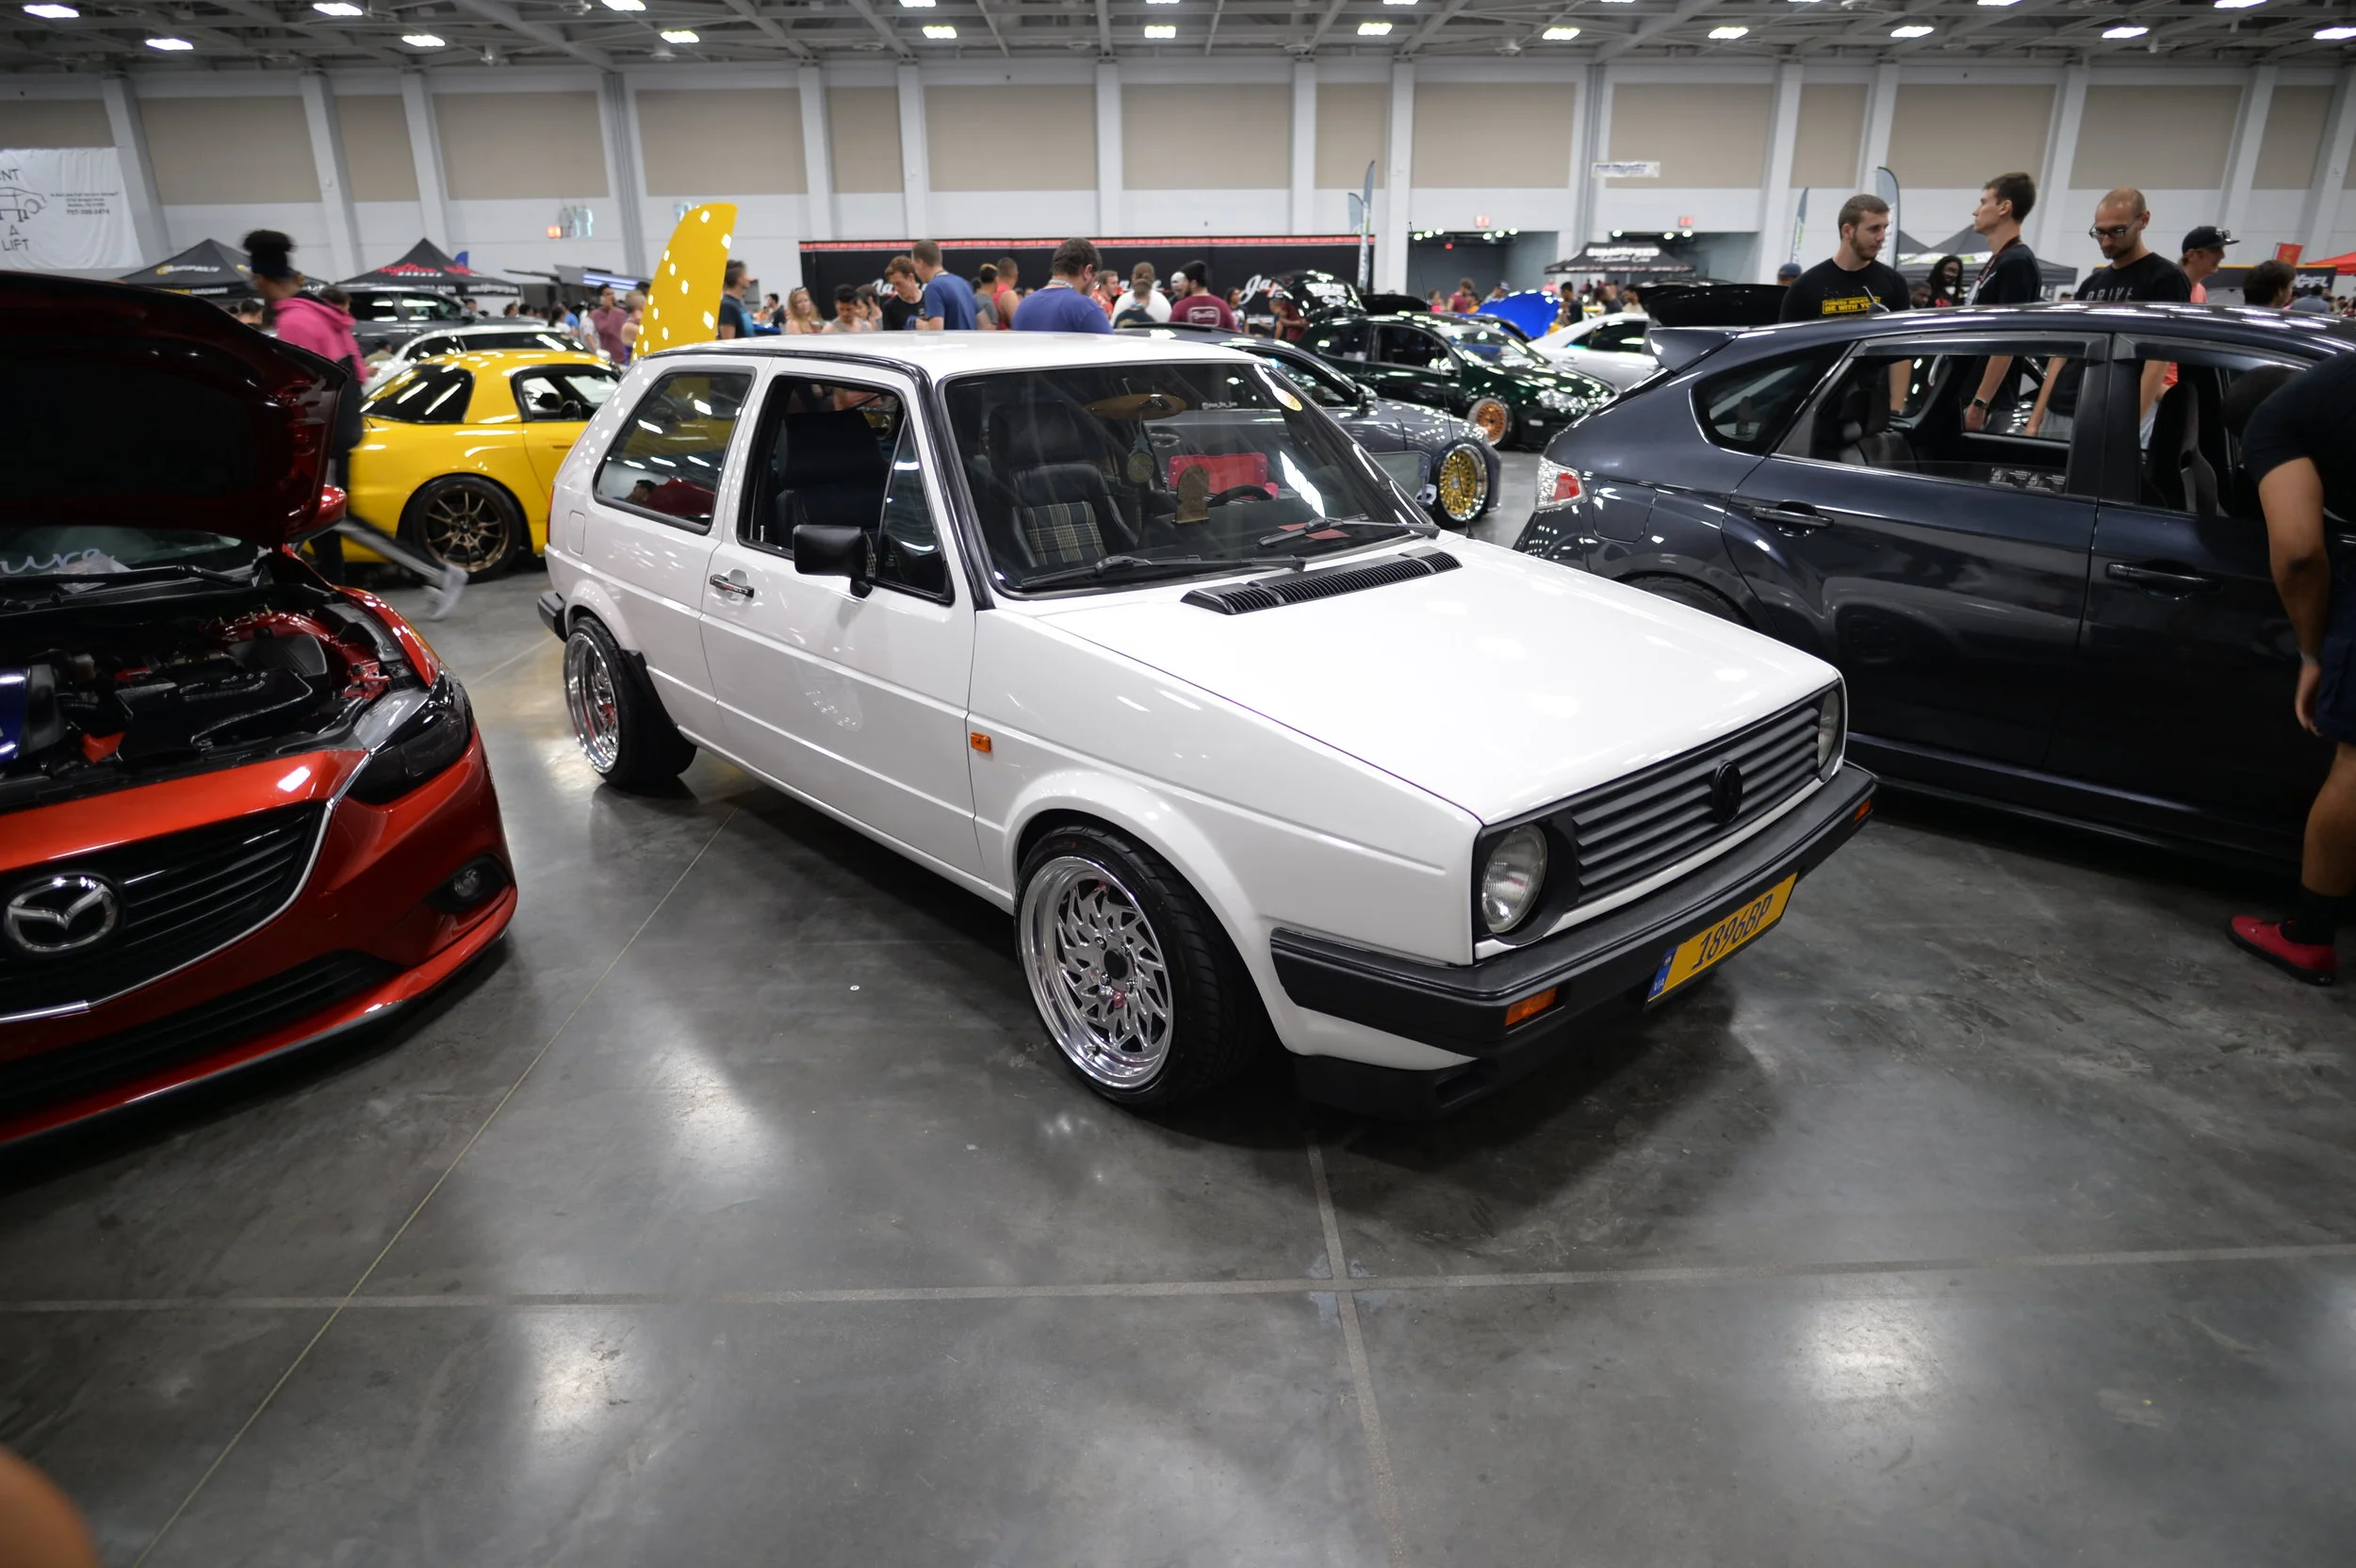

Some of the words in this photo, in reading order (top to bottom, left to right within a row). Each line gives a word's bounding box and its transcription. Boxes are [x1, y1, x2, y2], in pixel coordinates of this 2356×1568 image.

[0, 169, 19, 181] NT
[9, 224, 20, 236] A
[1, 238, 29, 251] LIFT
[2086, 286, 2134, 302] DRIVE
[1839, 303, 1859, 312] WITH
[1691, 893, 1774, 971] 1896BP
